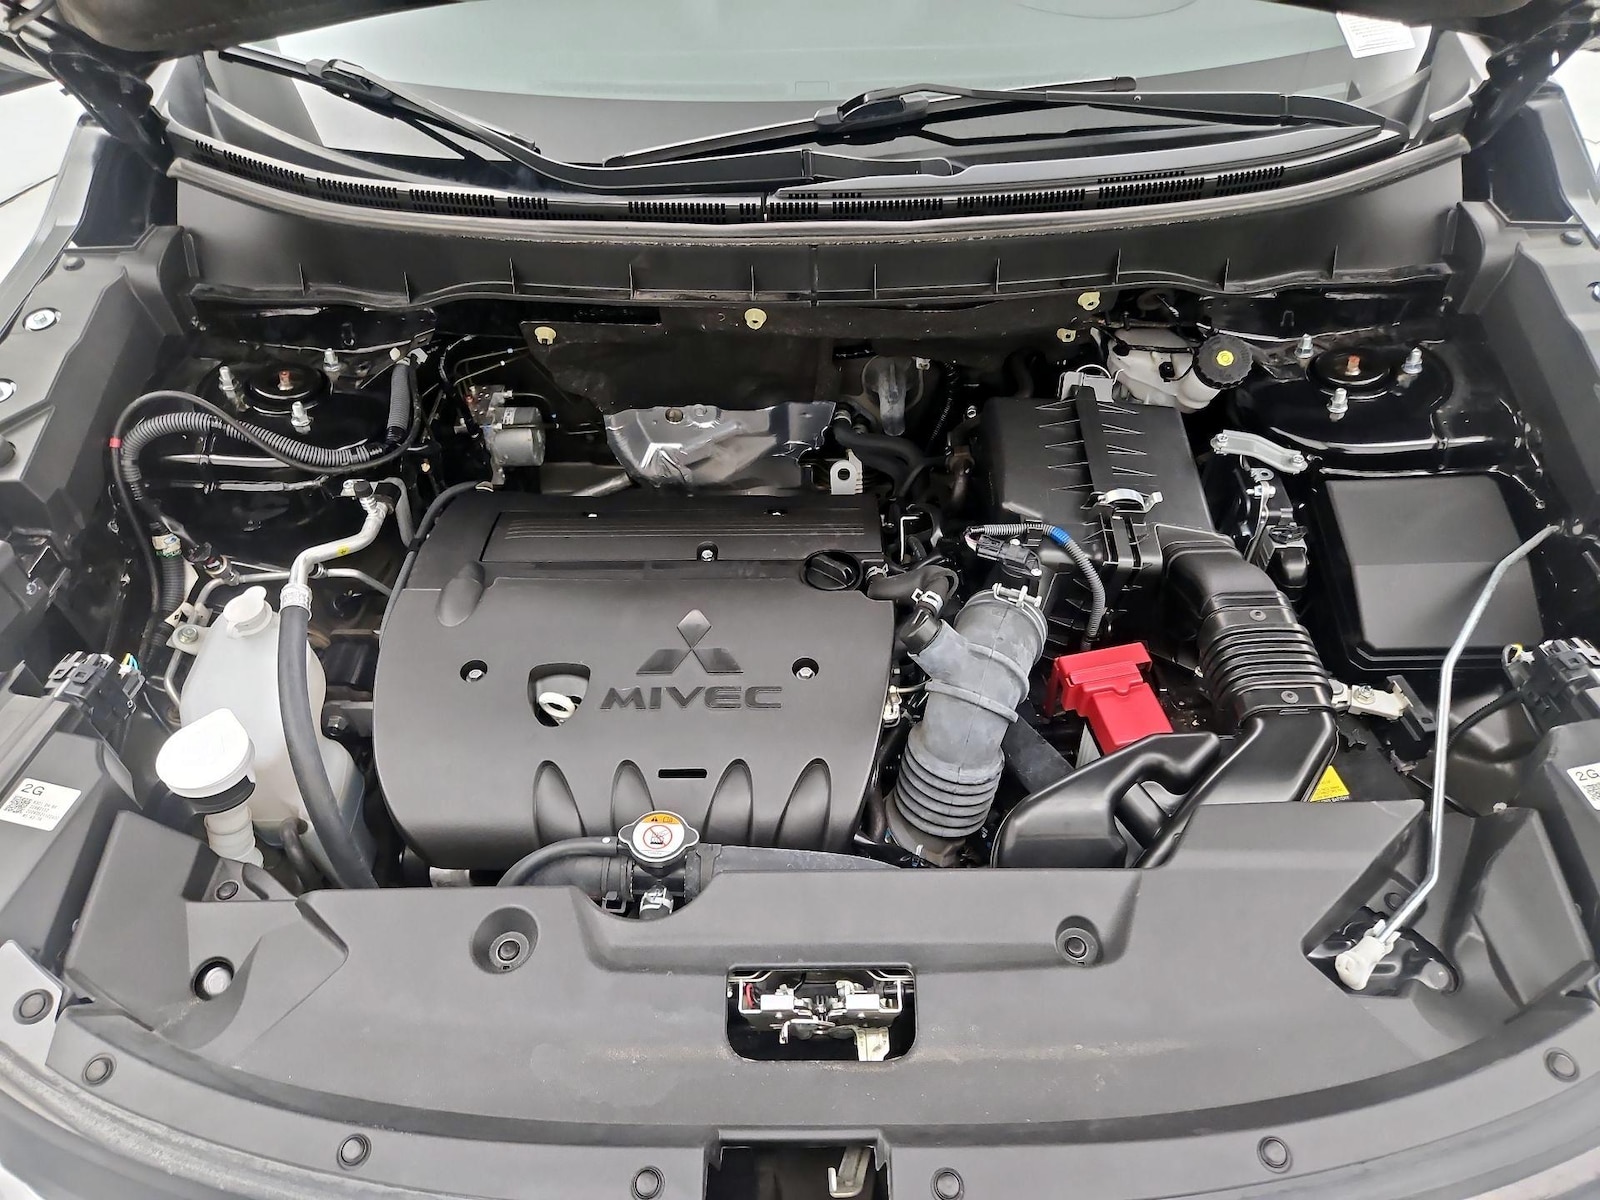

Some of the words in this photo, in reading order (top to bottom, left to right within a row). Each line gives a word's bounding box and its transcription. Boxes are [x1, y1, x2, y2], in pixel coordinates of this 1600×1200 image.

[600, 686, 782, 710] MIVEC
[1575, 768, 1600, 782] 2G
[21, 783, 45, 796] 2G
